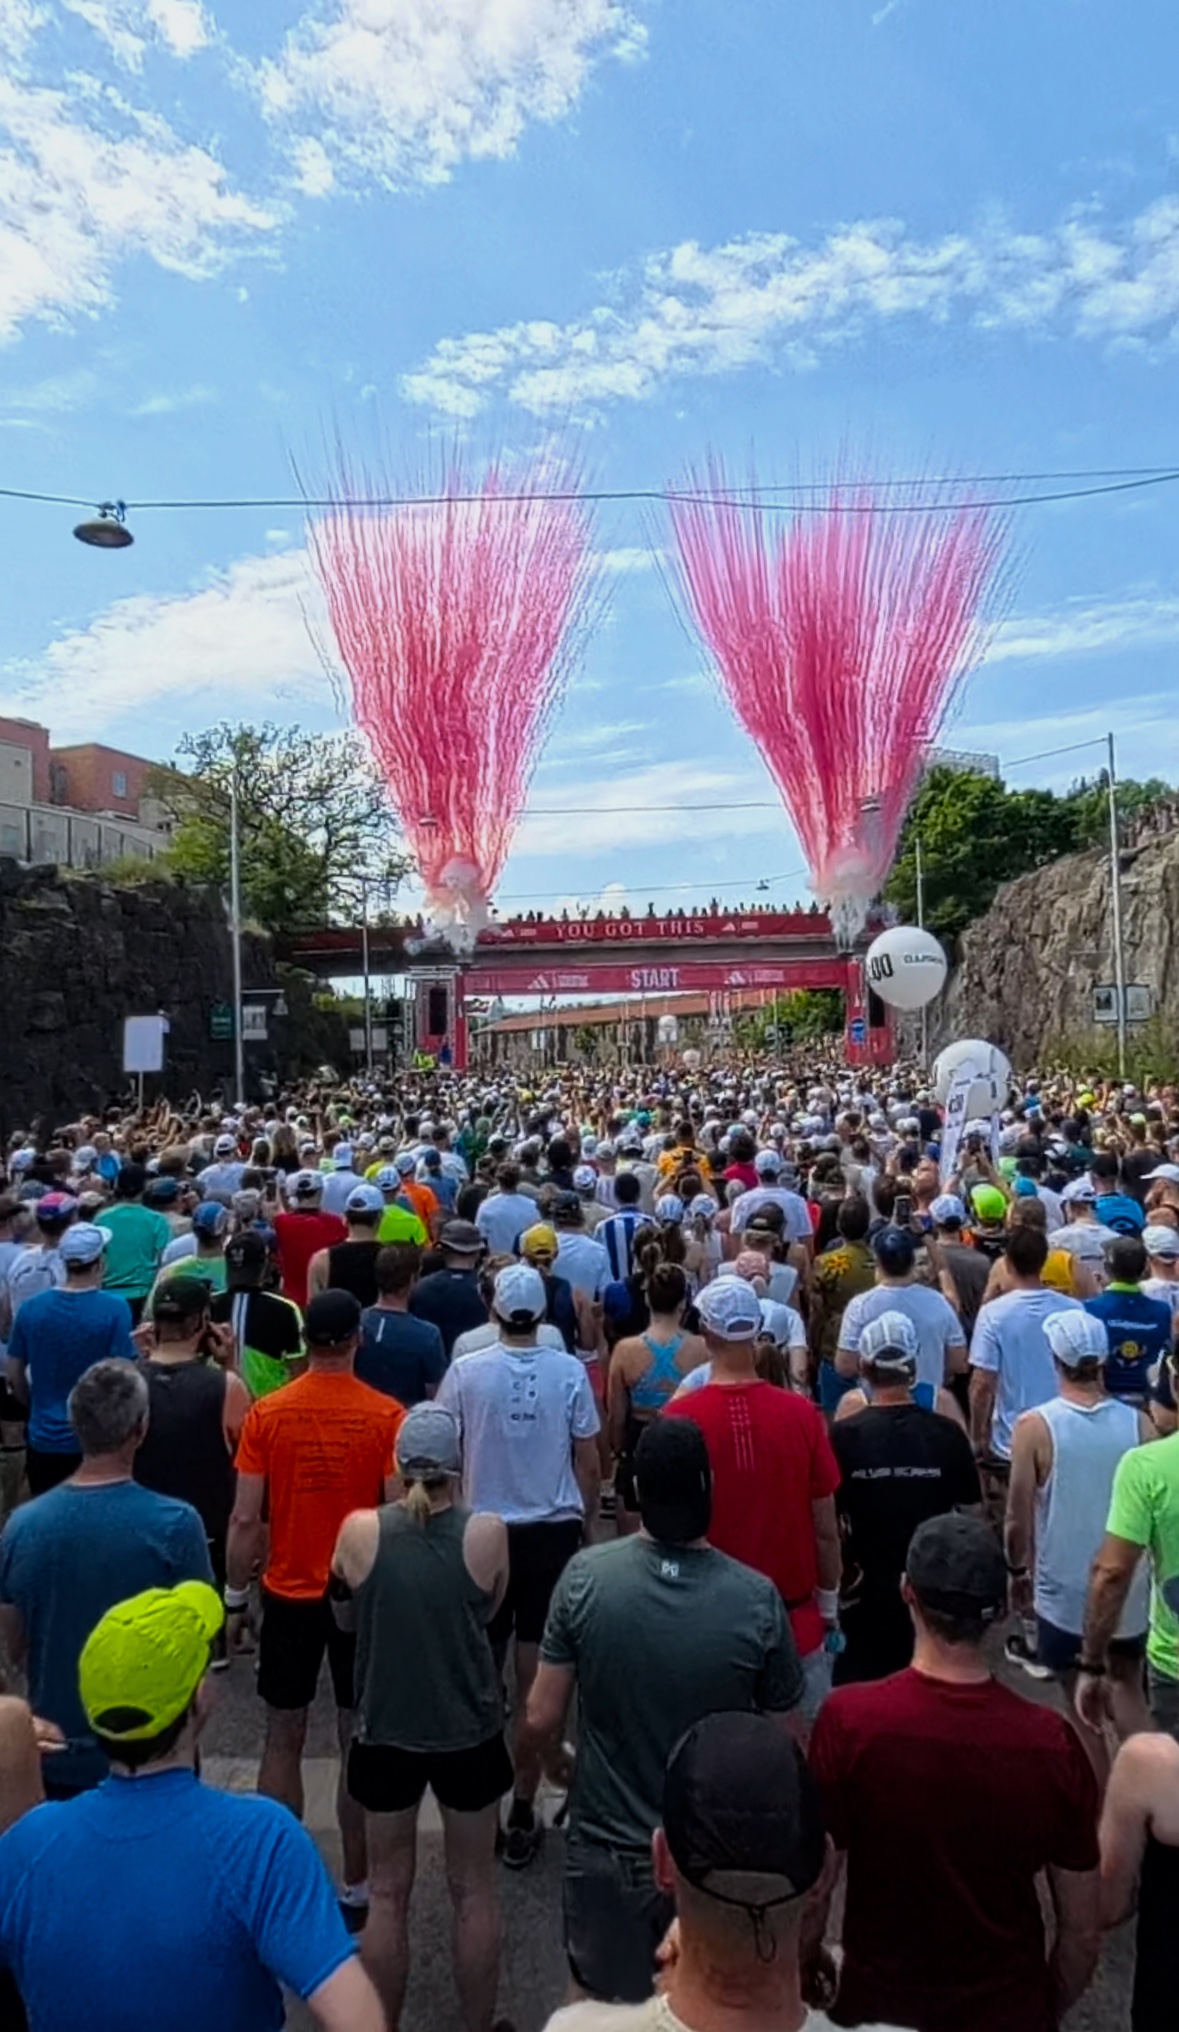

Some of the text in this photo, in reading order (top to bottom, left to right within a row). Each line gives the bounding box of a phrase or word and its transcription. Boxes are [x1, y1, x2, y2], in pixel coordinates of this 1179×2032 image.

[556, 920, 704, 937] YOU GOT THIS
[631, 968, 679, 988] START
